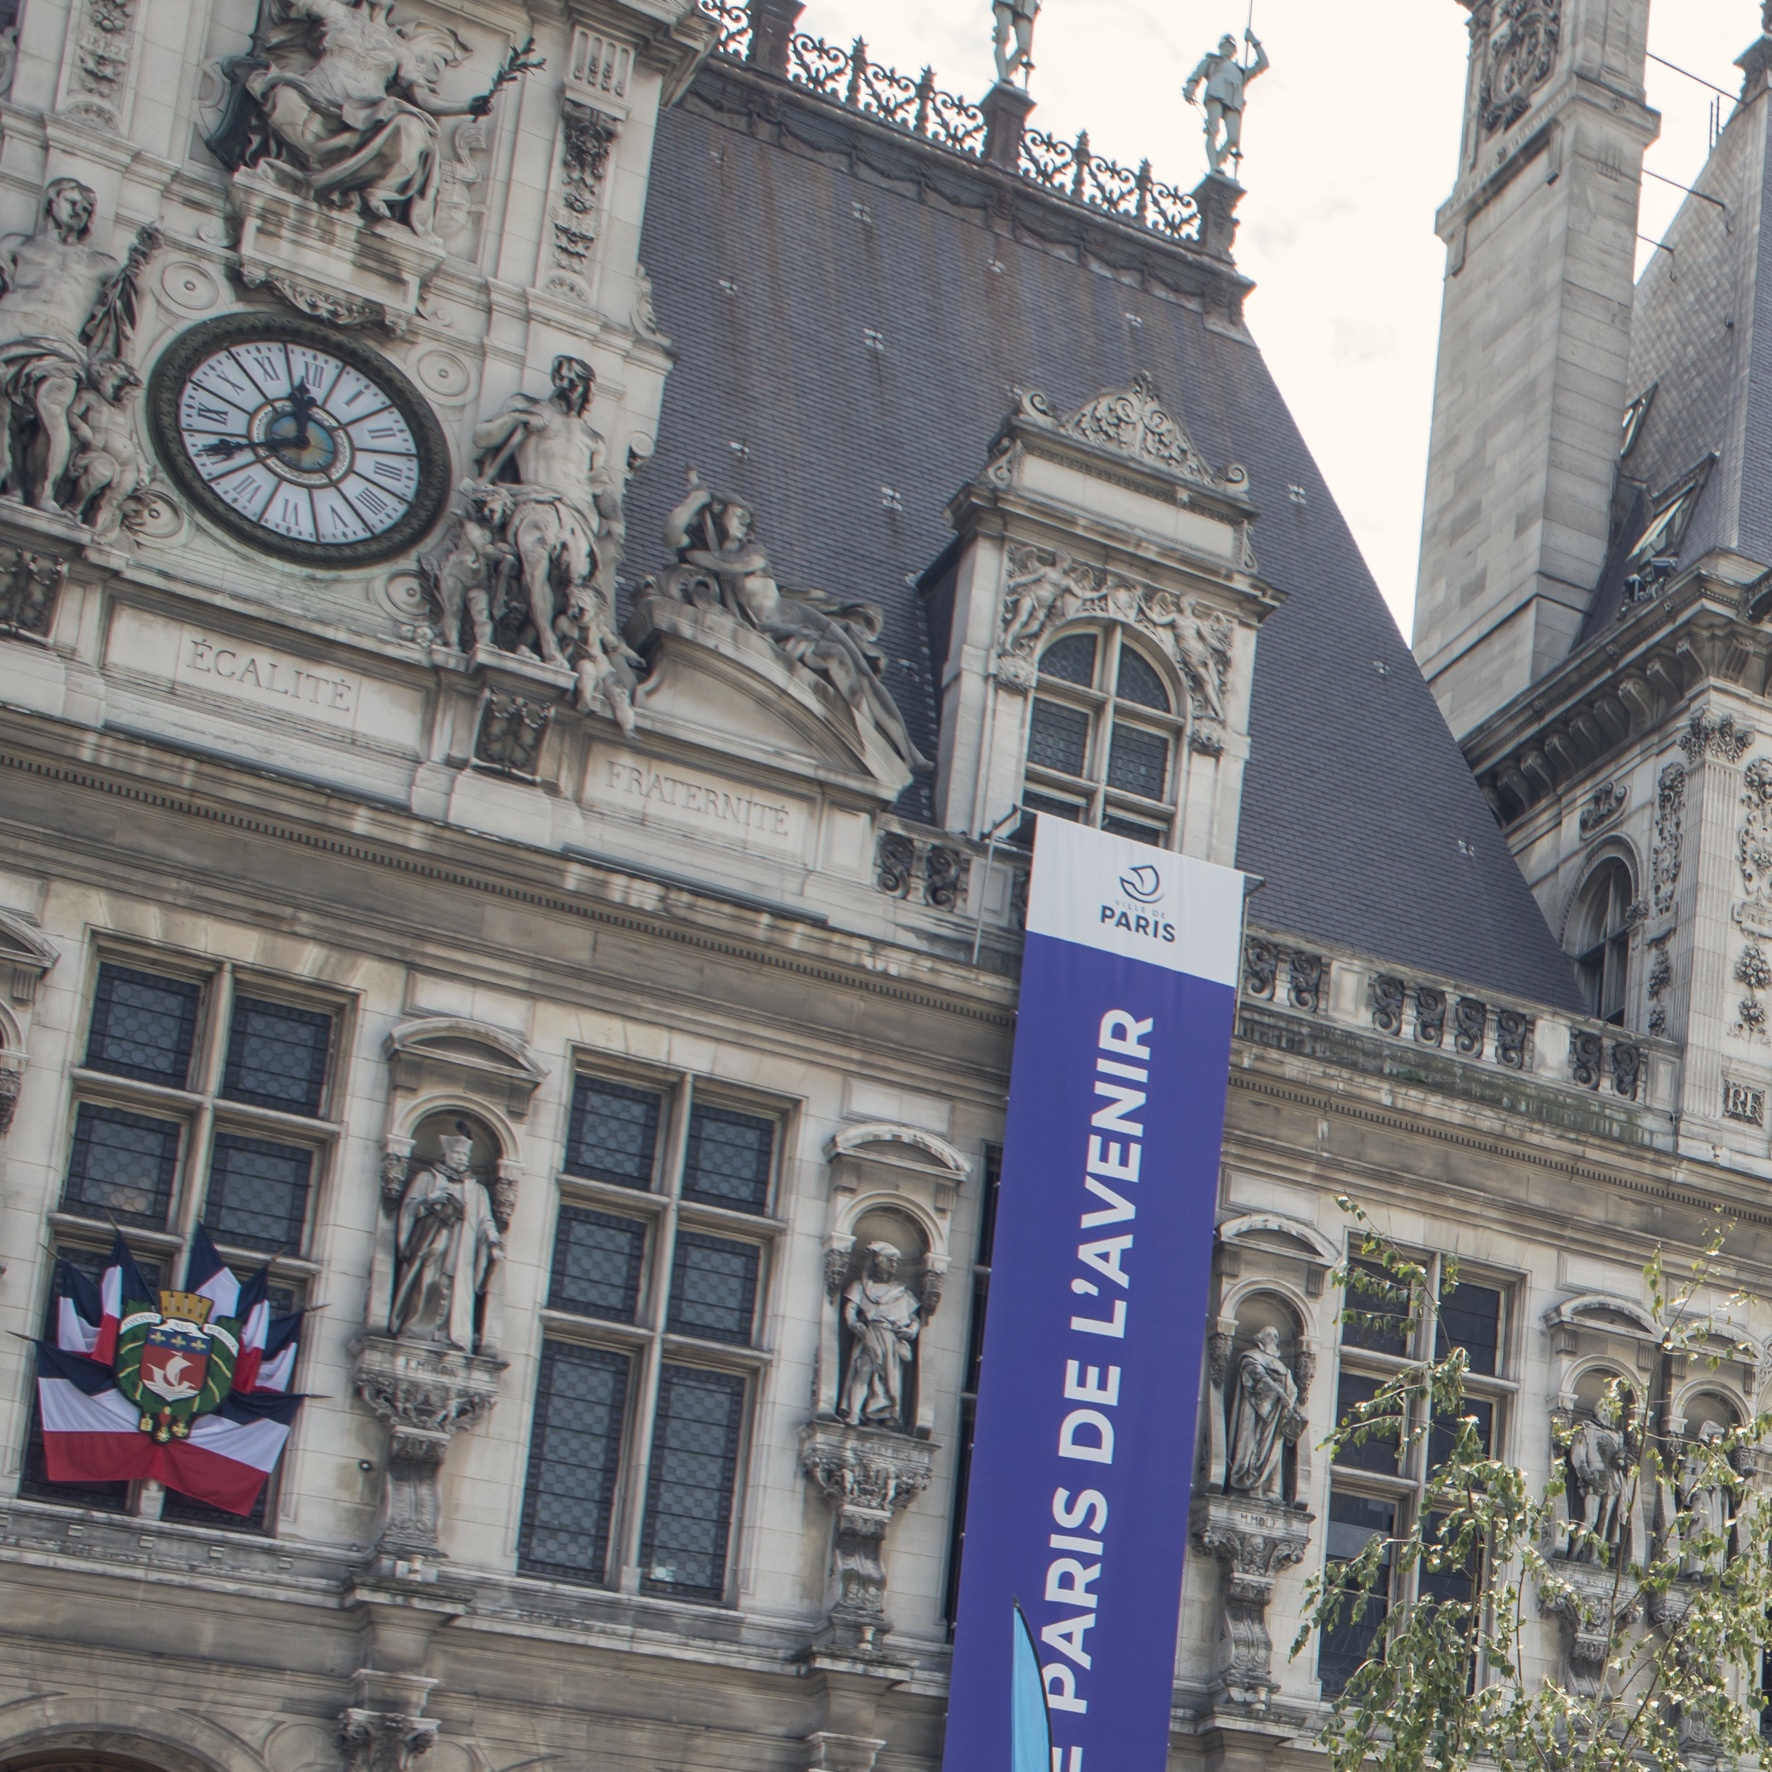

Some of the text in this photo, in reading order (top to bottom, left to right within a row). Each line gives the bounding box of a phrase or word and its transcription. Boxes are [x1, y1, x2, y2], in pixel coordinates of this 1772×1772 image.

[605, 760, 789, 836] FRATERNITÉ
[1100, 904, 1176, 943] PARIS
[1115, 898, 1166, 919] VILLE DE
[1070, 1008, 1154, 1339] L'AVENIR
[1058, 1360, 1121, 1467] DE
[1045, 1486, 1109, 1715] PARIS
